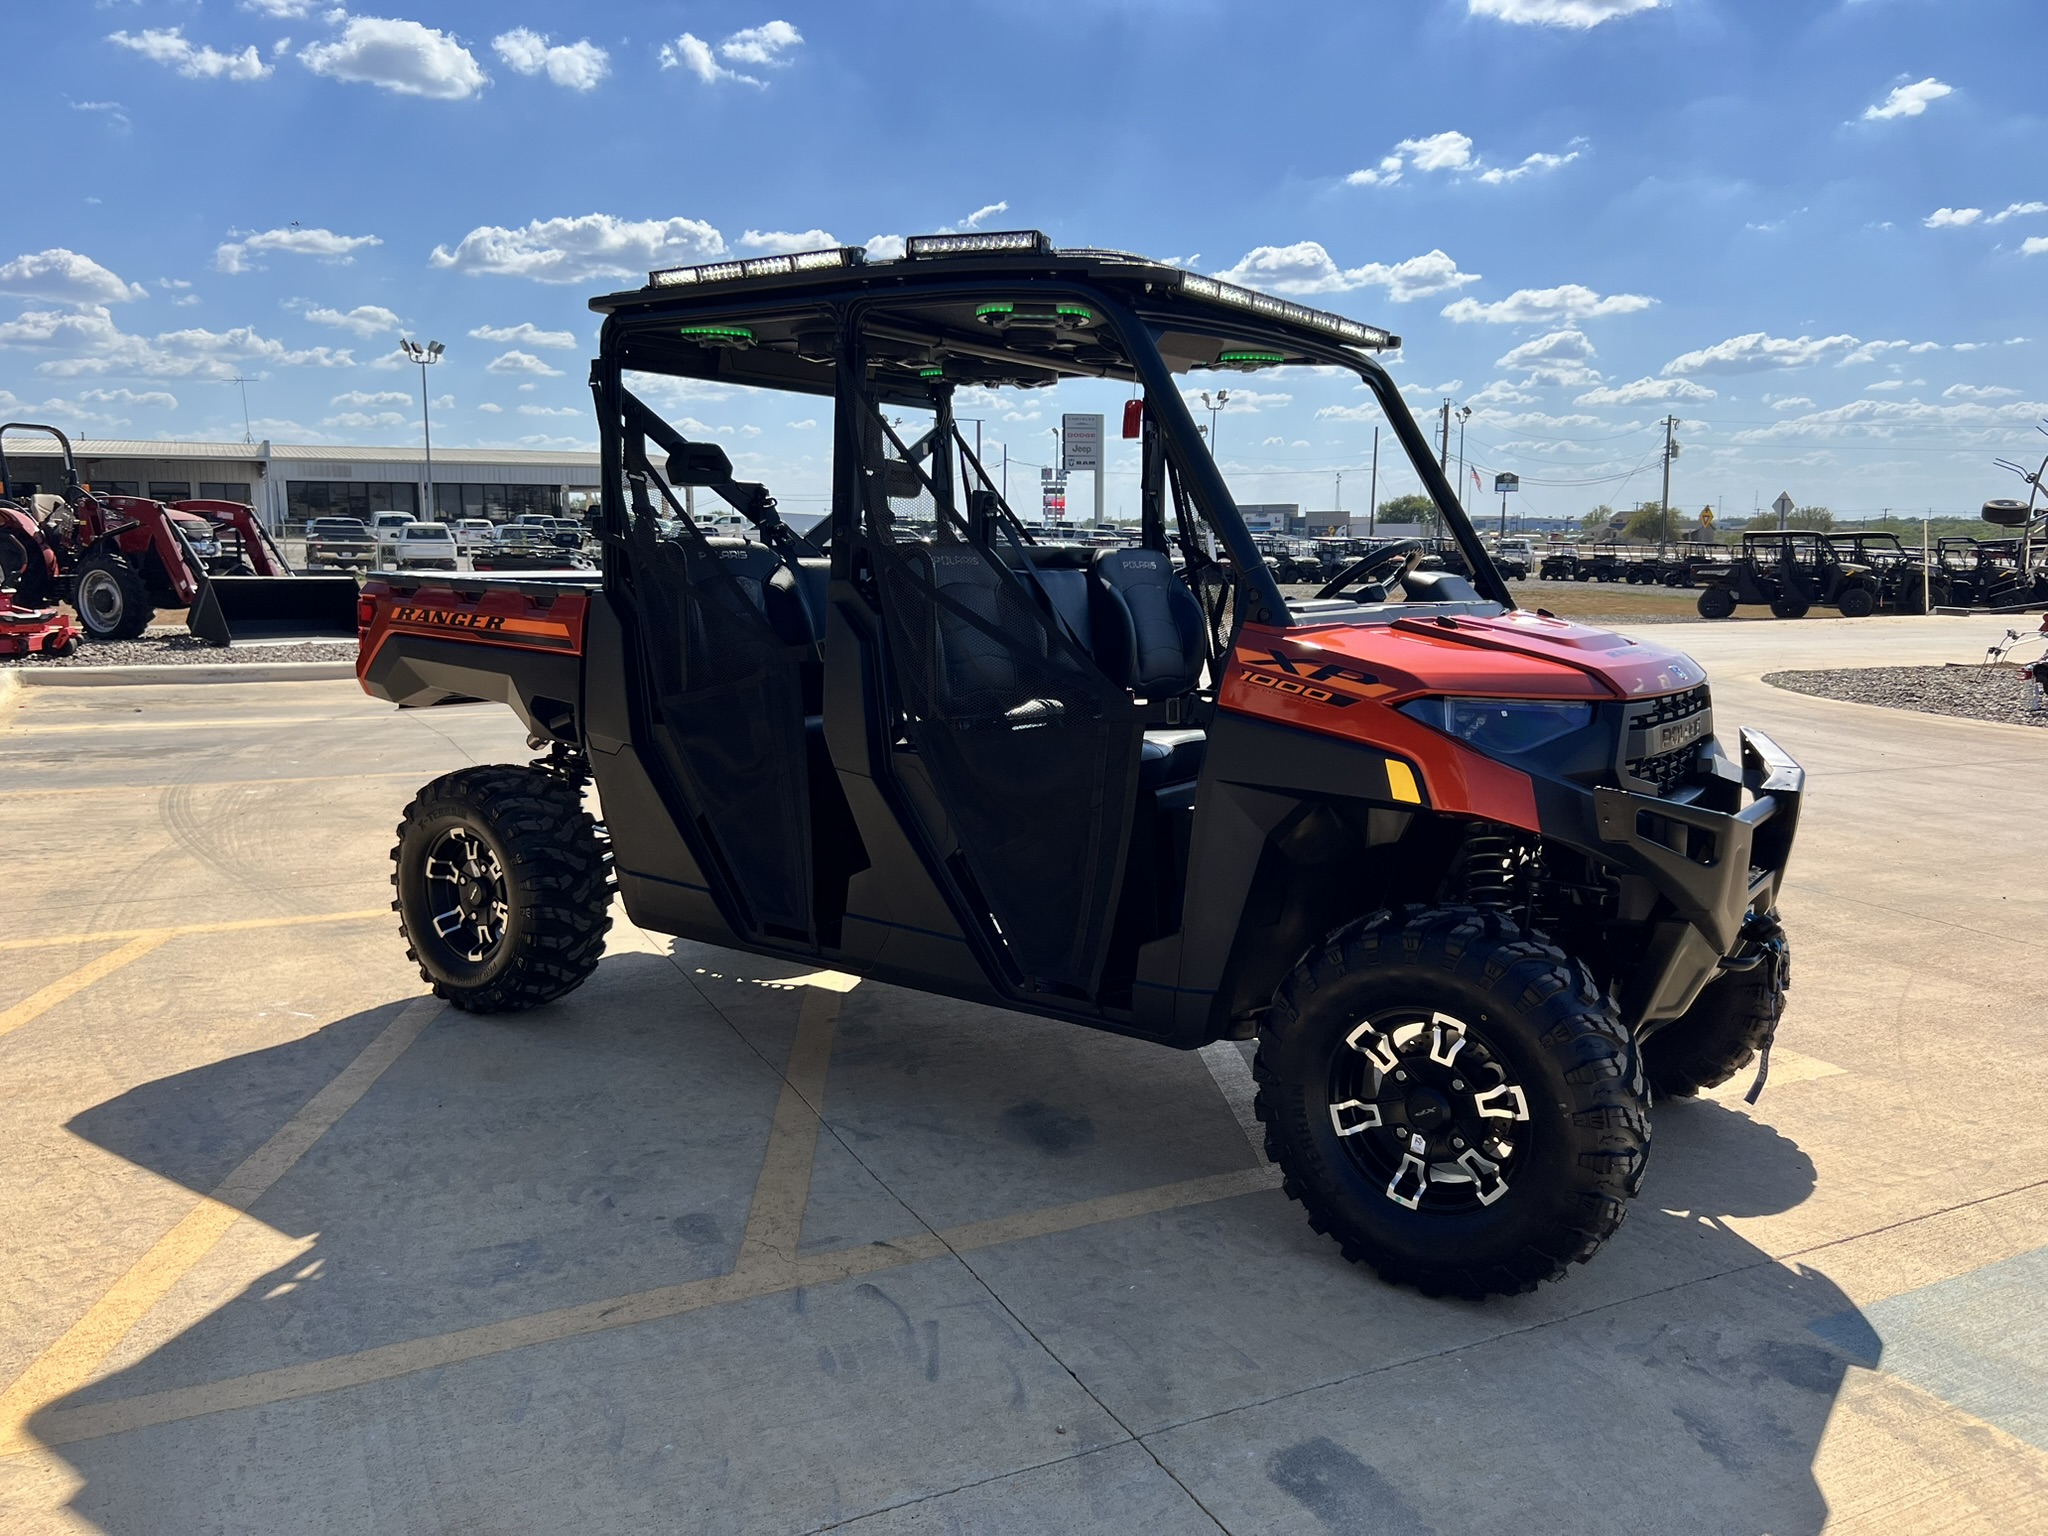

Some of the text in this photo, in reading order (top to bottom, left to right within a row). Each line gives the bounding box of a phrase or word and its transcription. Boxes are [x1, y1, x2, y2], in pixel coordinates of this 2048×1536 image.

[1072, 444, 1092, 454] Jeep
[698, 550, 748, 560] PLARIS
[1122, 560, 1157, 570] POLARIS
[396, 607, 506, 630] RANGER
[1244, 648, 1382, 685] XP
[1239, 670, 1334, 702] 1000
